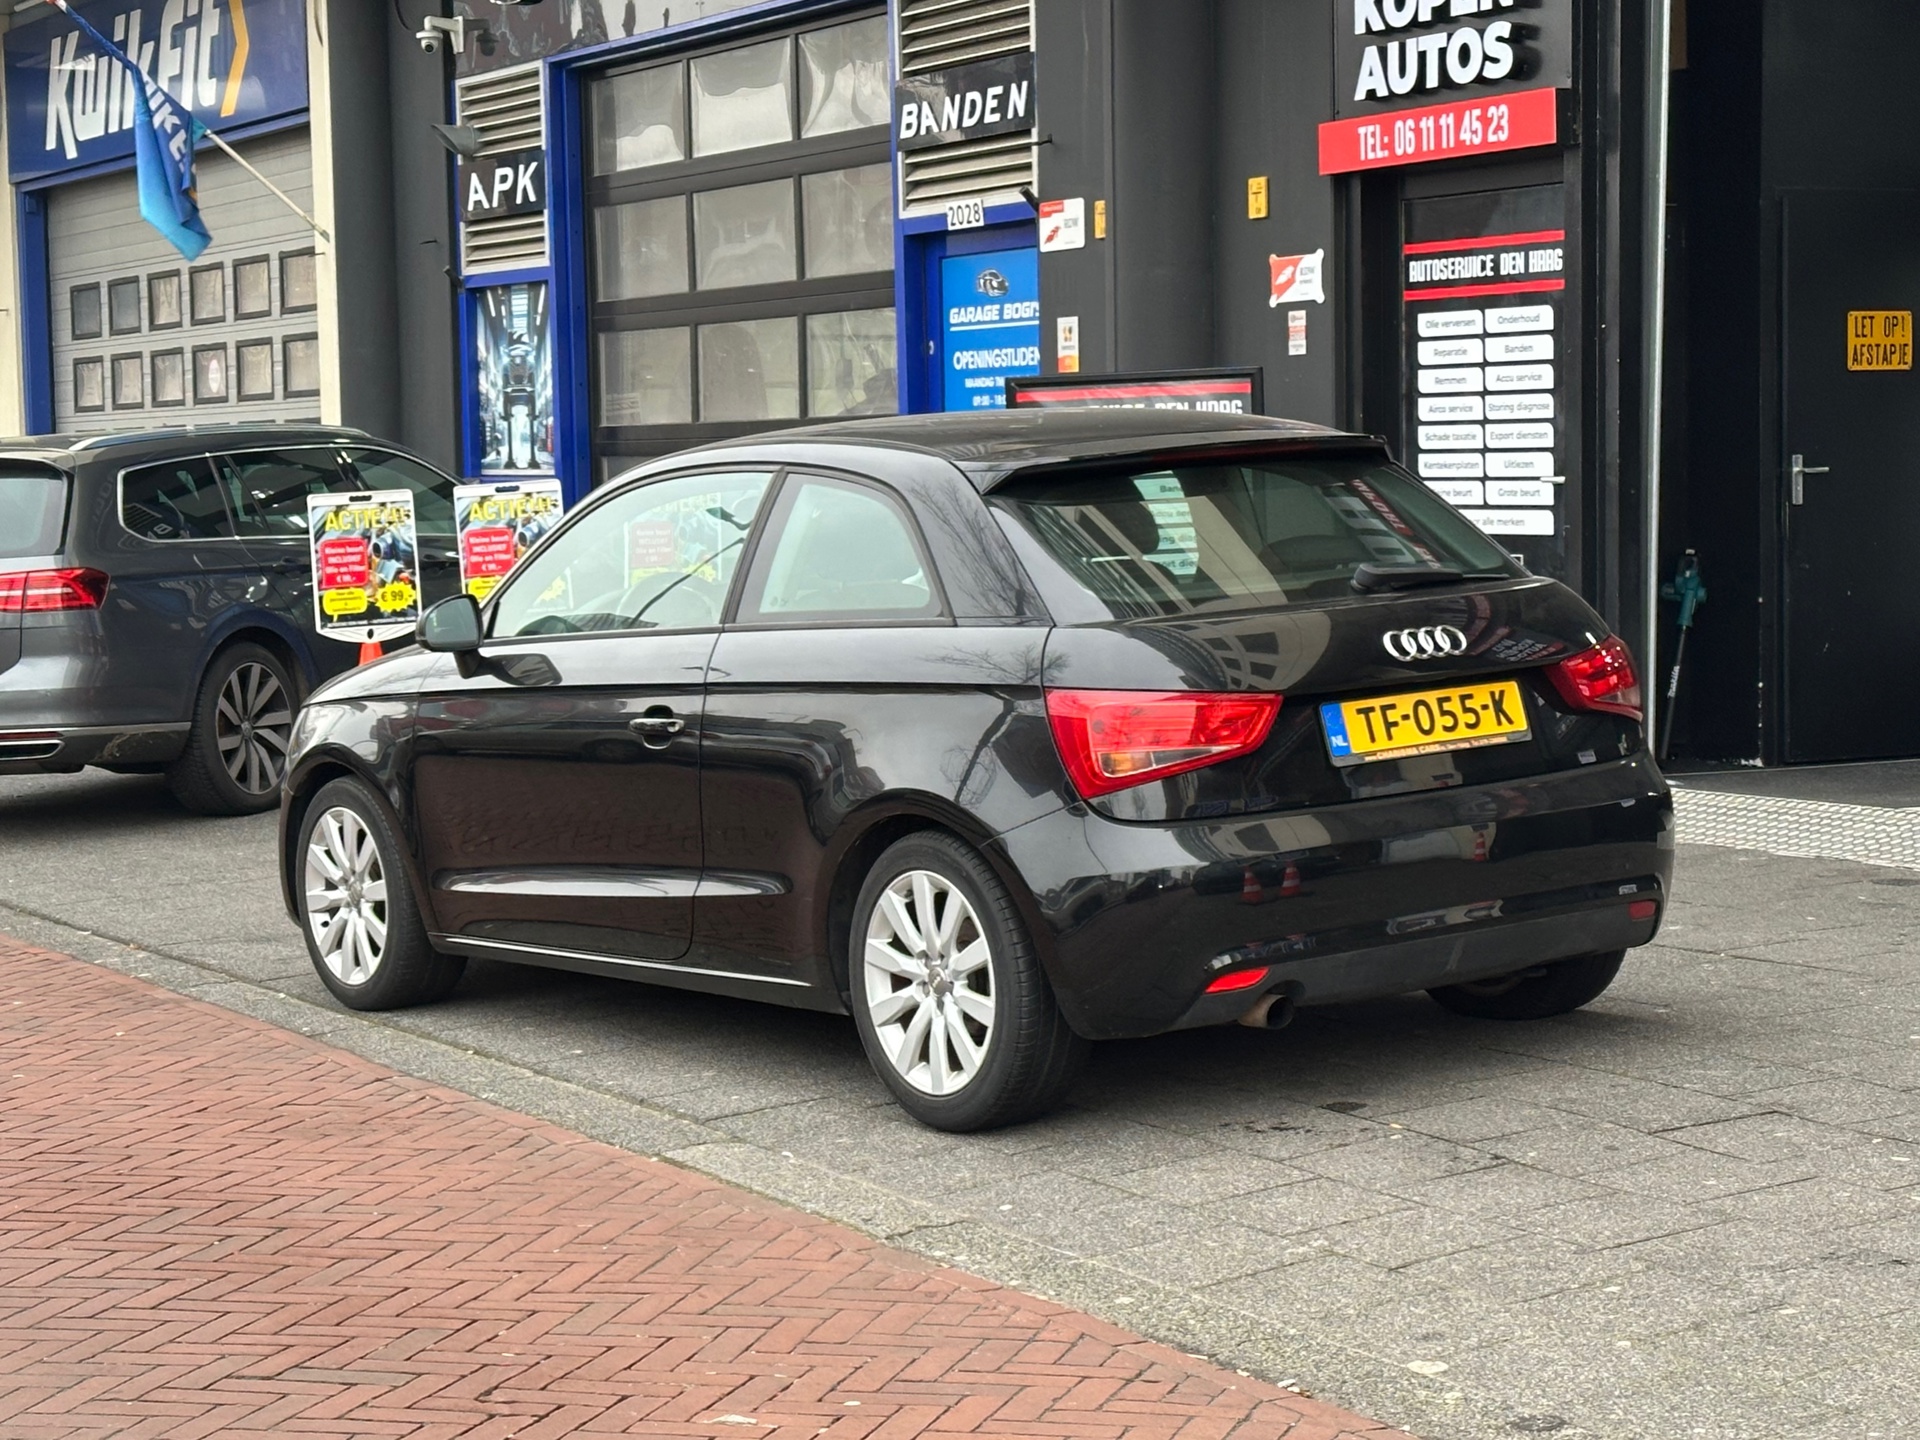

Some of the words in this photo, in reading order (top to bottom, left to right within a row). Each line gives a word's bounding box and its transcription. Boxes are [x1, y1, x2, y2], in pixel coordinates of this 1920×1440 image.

[1353, 20, 1514, 101] AUTOS
[45, 8, 155, 160] Kwik
[899, 81, 1029, 139] BANDEN
[1357, 123, 1390, 161] TEL:
[1393, 118, 1416, 156] 06
[1419, 115, 1435, 151] 11
[1439, 112, 1455, 149] 11
[1459, 108, 1483, 146] 45
[1487, 104, 1509, 143] 23
[467, 161, 538, 211] APK
[948, 202, 982, 227] 2028
[1409, 254, 1495, 283] AUTOSERVICE
[1499, 251, 1526, 276] DEN
[1528, 248, 1563, 273] HAAG
[949, 304, 1001, 324] GARAGE
[1854, 315, 1875, 339] LET
[1883, 315, 1906, 339] OP!
[1851, 343, 1909, 367] AFSTAPJE
[1355, 689, 1515, 744] TF-055-K
[1331, 735, 1348, 748] NL
